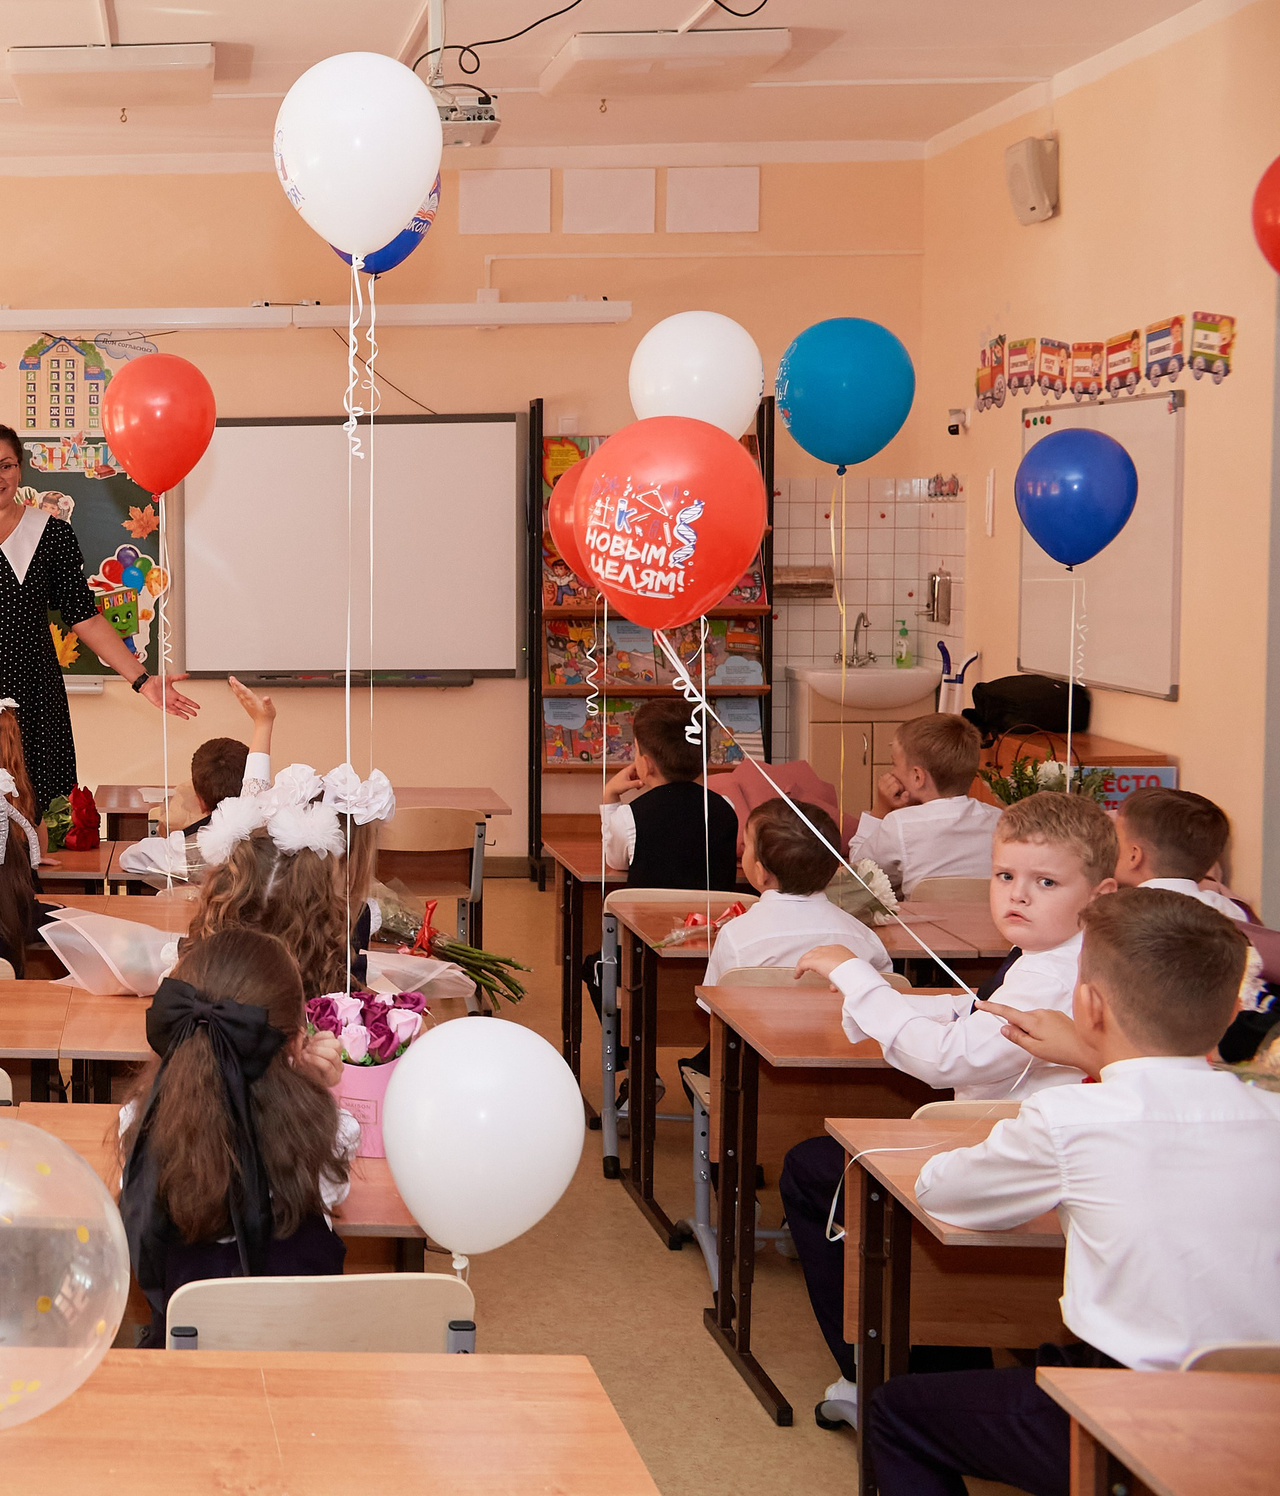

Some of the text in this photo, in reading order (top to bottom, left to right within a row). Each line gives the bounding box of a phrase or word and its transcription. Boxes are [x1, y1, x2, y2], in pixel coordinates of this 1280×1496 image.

[615, 498, 638, 534] К
[585, 526, 667, 567] НОВЫМ
[590, 553, 685, 593] ЦЕЛЯМ!
[103, 590, 137, 610] БУКВАРЬ
[1103, 774, 1162, 793] ЕСТО
